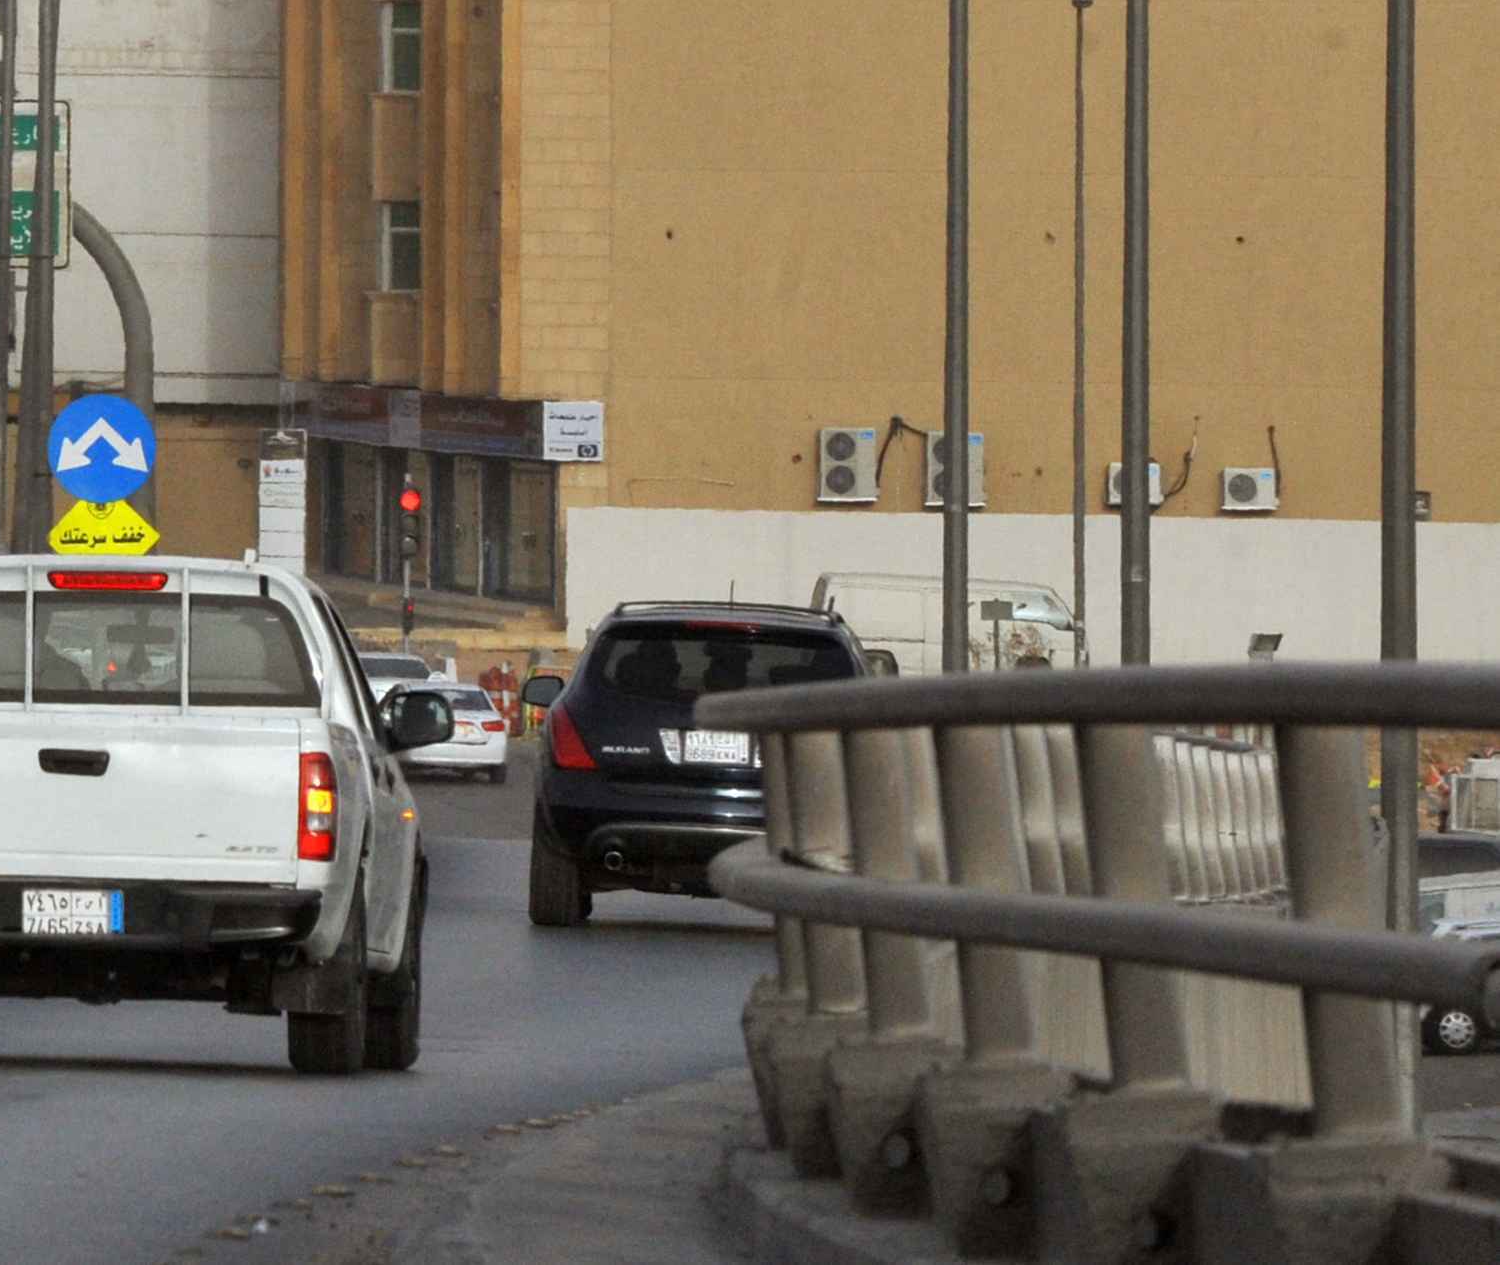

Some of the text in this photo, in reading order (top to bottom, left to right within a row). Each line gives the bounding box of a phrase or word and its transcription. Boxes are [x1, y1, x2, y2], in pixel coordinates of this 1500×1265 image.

[59, 525, 146, 549] خفف سرعتك
[26, 893, 69, 913] ٧٤٦٥
